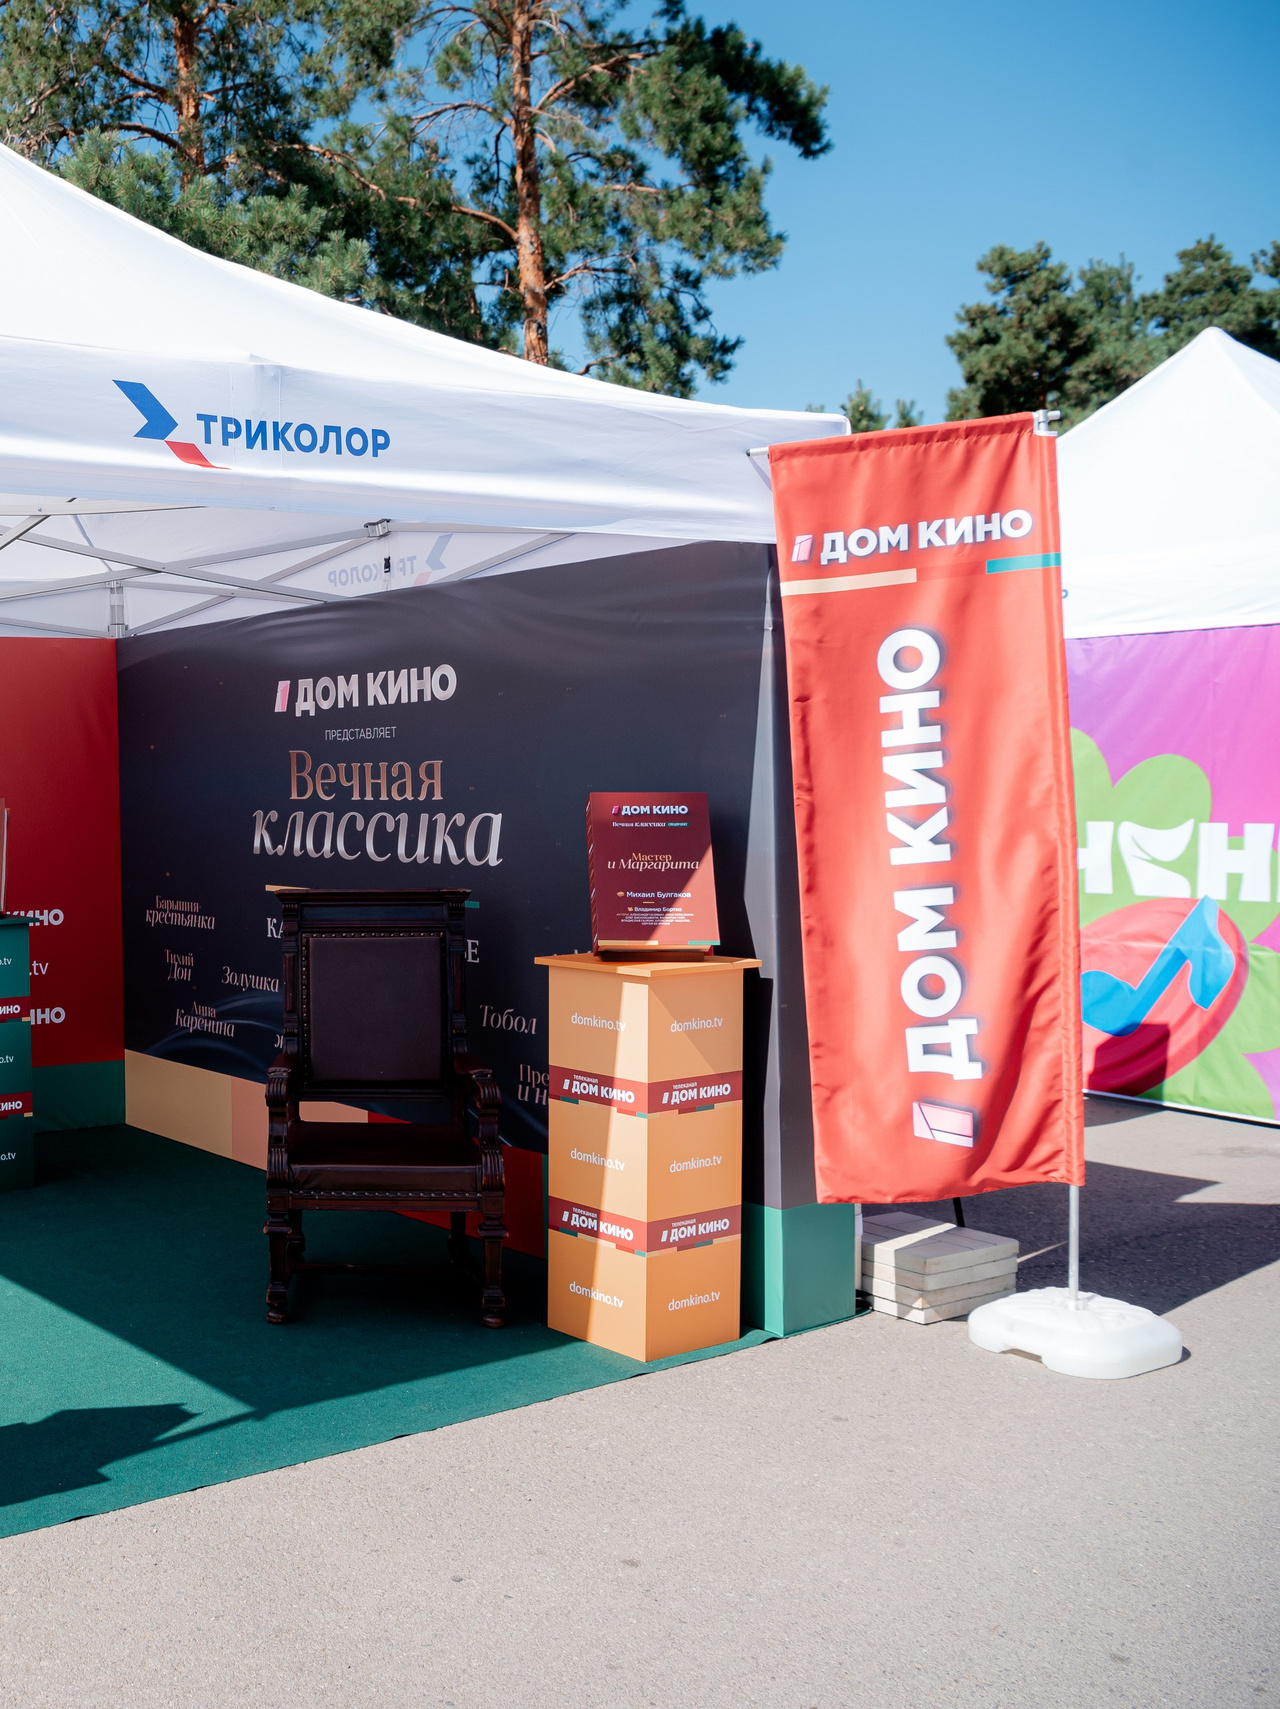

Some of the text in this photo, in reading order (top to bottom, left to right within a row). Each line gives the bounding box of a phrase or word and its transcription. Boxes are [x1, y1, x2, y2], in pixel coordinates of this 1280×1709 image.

[196, 413, 390, 457] ТРИКОЛОР
[820, 509, 1032, 565] ДОМ КИНО
[295, 663, 457, 717] ДОМ КИНО
[325, 726, 397, 742] ПРЕДСТАВЛЯЕТ
[289, 750, 443, 801] Вечная
[622, 805, 688, 816] ДОМ КИНО
[252, 810, 503, 867] классика
[607, 858, 699, 872] и Маргарита
[632, 852, 672, 864] Мастер
[877, 628, 982, 1080] ДОМ КИНО
[145, 909, 216, 930] крестьянка
[168, 963, 192, 982] Дон
[221, 966, 279, 993] Золушка
[175, 1009, 235, 1038] Каренина
[479, 1004, 537, 1035] Тобол
[571, 1012, 626, 1032] domkino.tv
[670, 1016, 723, 1032] domkino.tv
[572, 1080, 634, 1104] ДОМ КИНО
[671, 1083, 731, 1105] ДОМ КИНО
[570, 1148, 624, 1171] domkino.tv
[670, 1154, 722, 1173] domkino.tv
[571, 1213, 634, 1241] ДОМ КИНО
[670, 1218, 730, 1242] ДОМ КИНО
[569, 1280, 624, 1308] domkino.tv
[668, 1290, 720, 1312] domkino.tv
